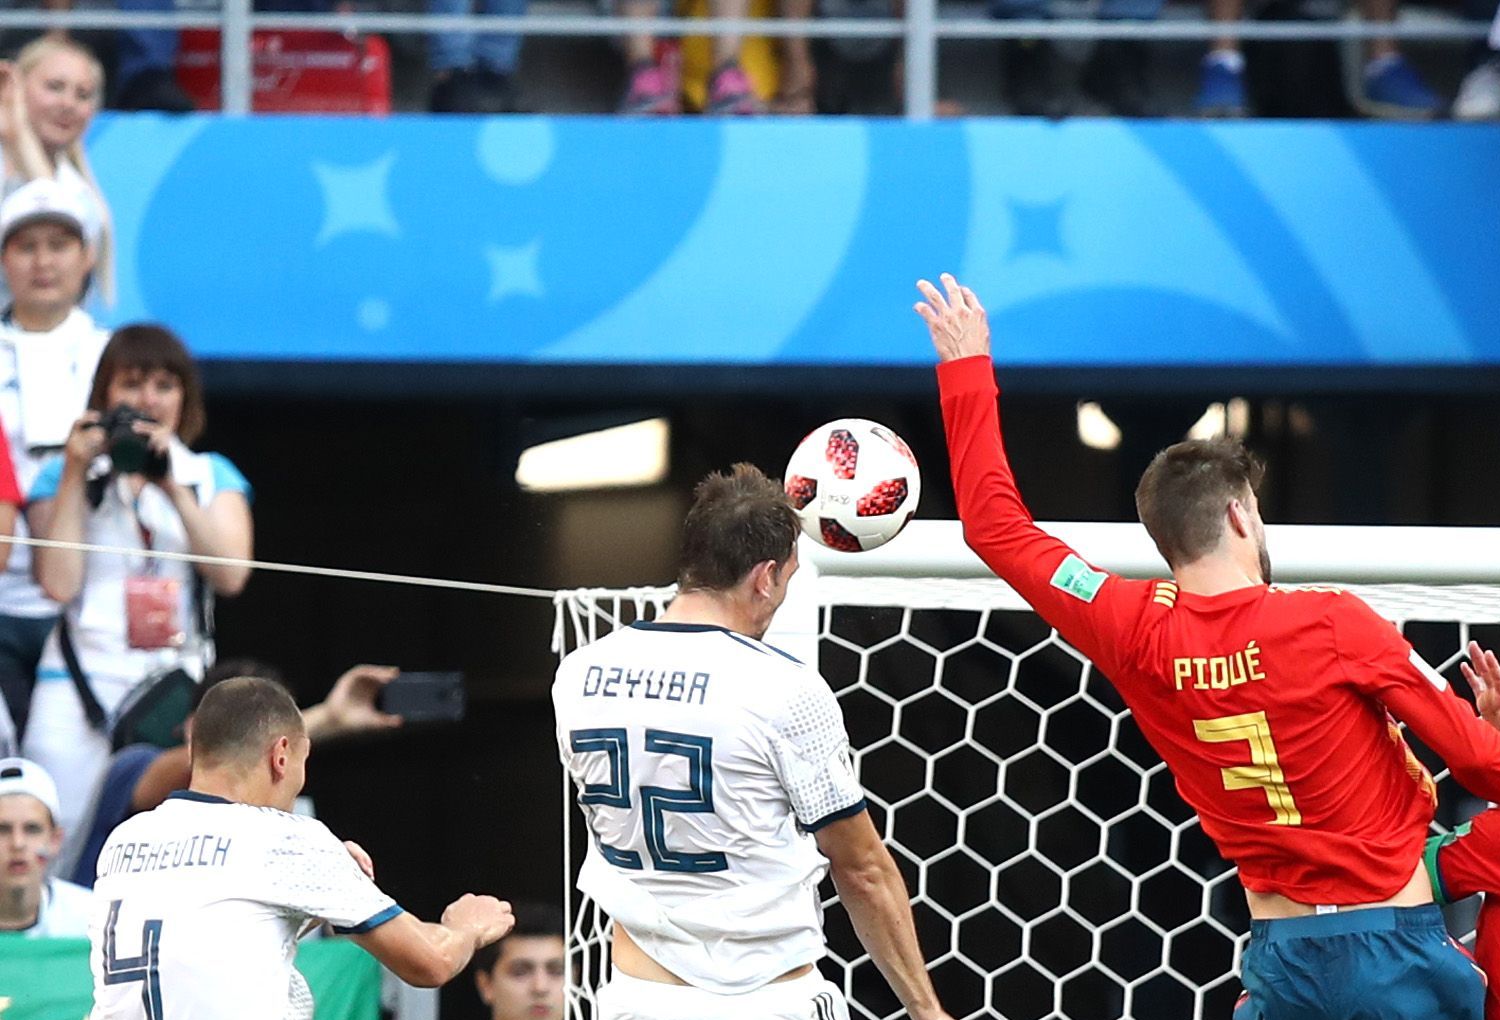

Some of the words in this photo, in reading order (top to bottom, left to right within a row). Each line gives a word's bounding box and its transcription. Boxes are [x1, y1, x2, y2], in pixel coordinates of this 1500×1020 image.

[583, 665, 711, 705] DZYUBA
[1173, 640, 1267, 691] PIQUÉ
[569, 727, 730, 873] 22
[1191, 710, 1303, 826] 3
